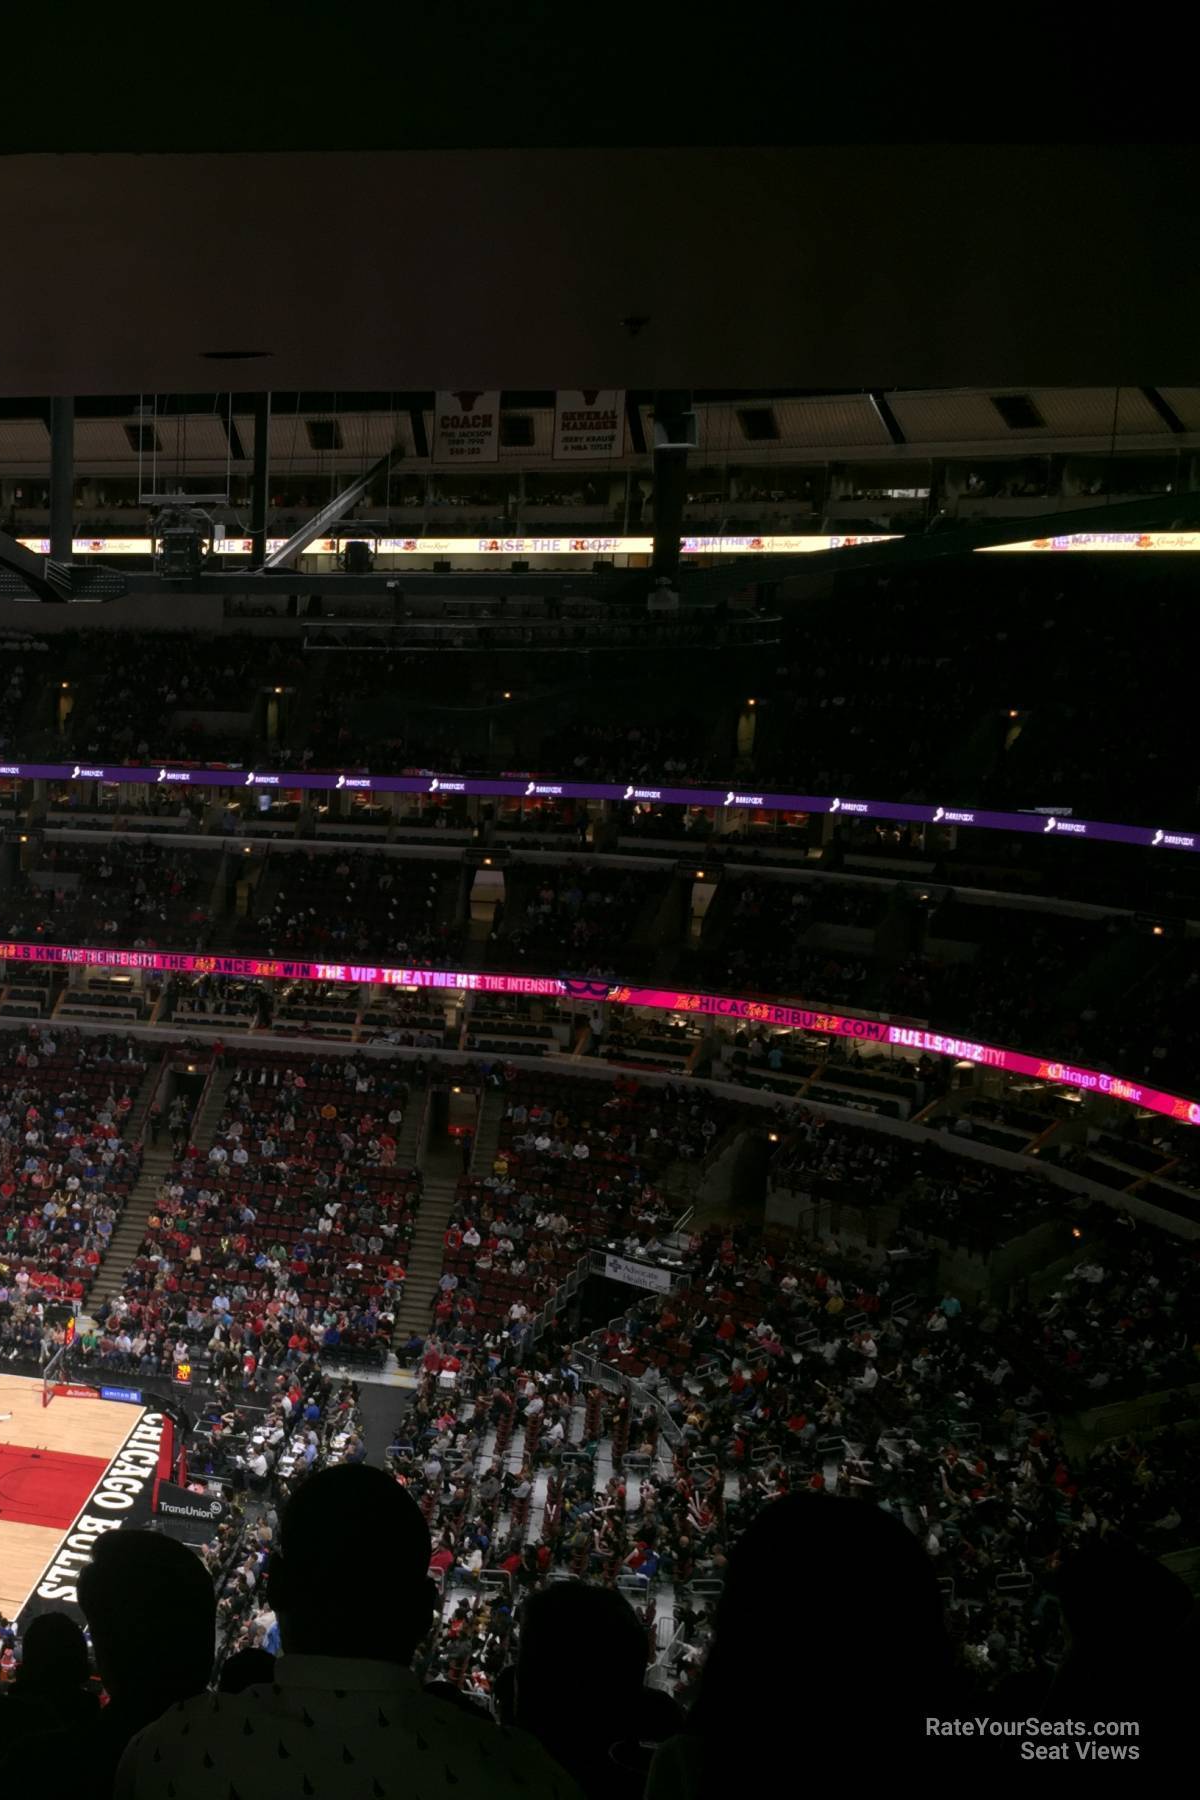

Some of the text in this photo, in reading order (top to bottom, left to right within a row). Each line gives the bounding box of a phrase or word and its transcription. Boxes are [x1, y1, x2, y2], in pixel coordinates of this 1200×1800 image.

[440, 415, 493, 429] COACH
[561, 411, 618, 421] GENERAL
[561, 421, 617, 431] MANAGER
[532, 540, 561, 552] THE
[61, 948, 84, 962] FACE
[106, 951, 157, 967] INTENSITY!
[161, 955, 187, 969] THE
[282, 963, 311, 977] WIN
[315, 964, 346, 980] THE
[350, 966, 378, 982] VIP
[485, 976, 505, 990] THE
[1047, 1062, 1143, 1102] Chicago Tribune
[36, 1412, 164, 1603] CHICAGO BULLS
[161, 1502, 214, 1519] TransUnion
